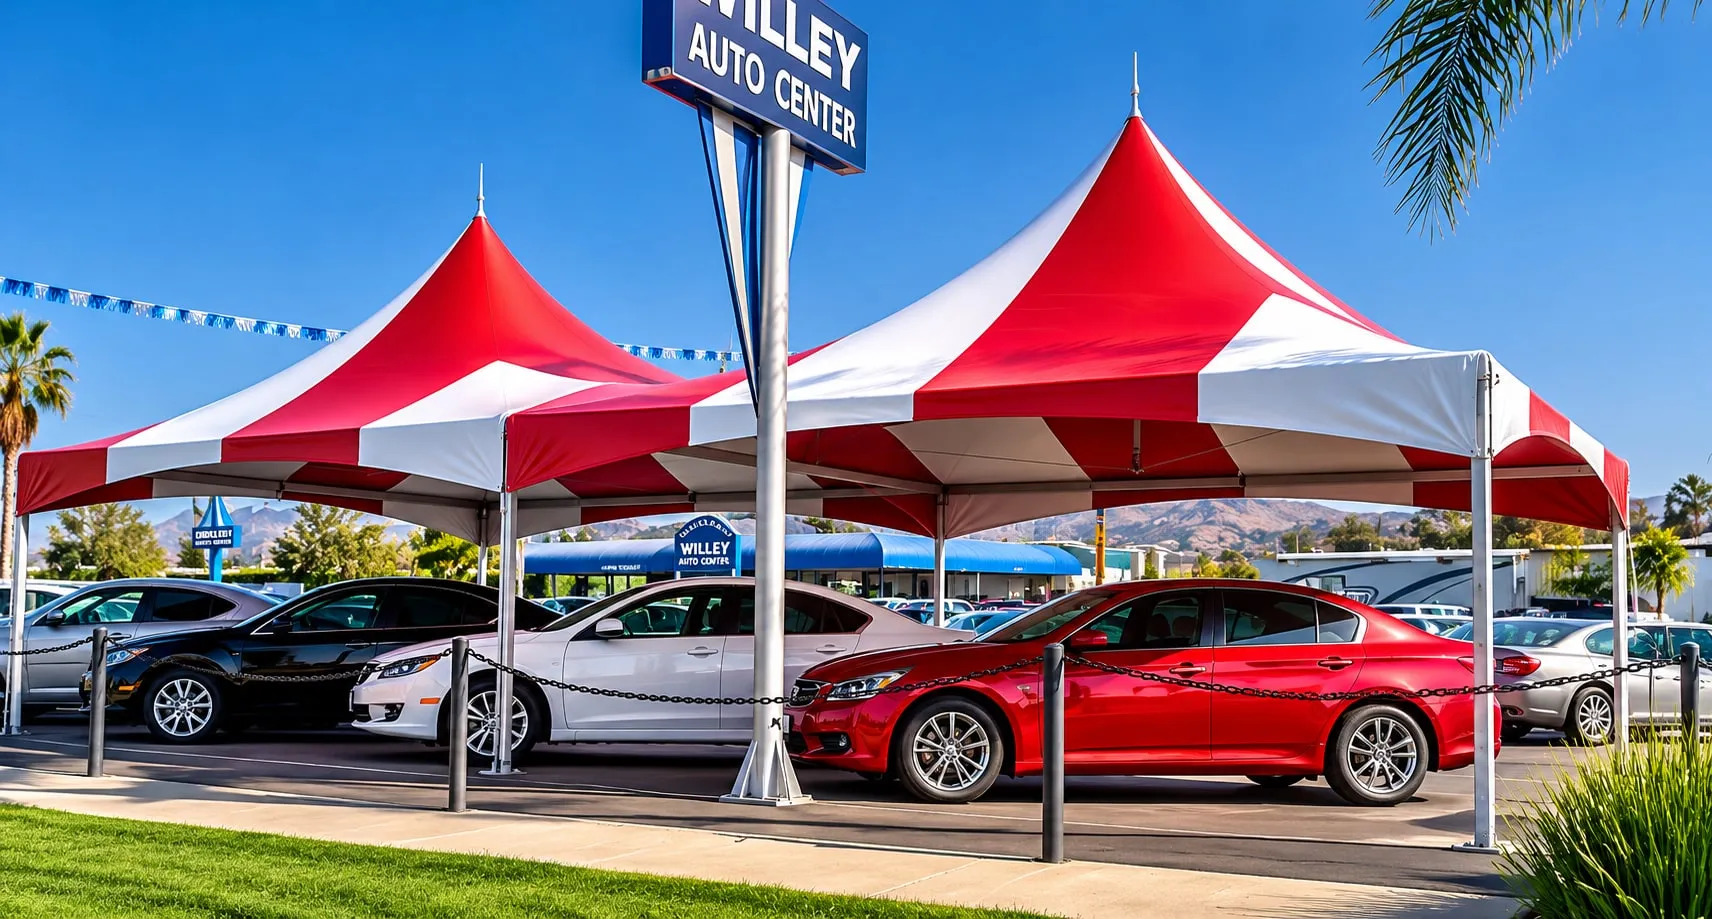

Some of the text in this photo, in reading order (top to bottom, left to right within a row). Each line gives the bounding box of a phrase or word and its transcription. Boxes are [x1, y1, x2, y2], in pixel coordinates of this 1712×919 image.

[688, 22, 857, 149] AUTO CENTER
[697, 0, 862, 92] ILLEY
[680, 541, 731, 556] WILLEY
